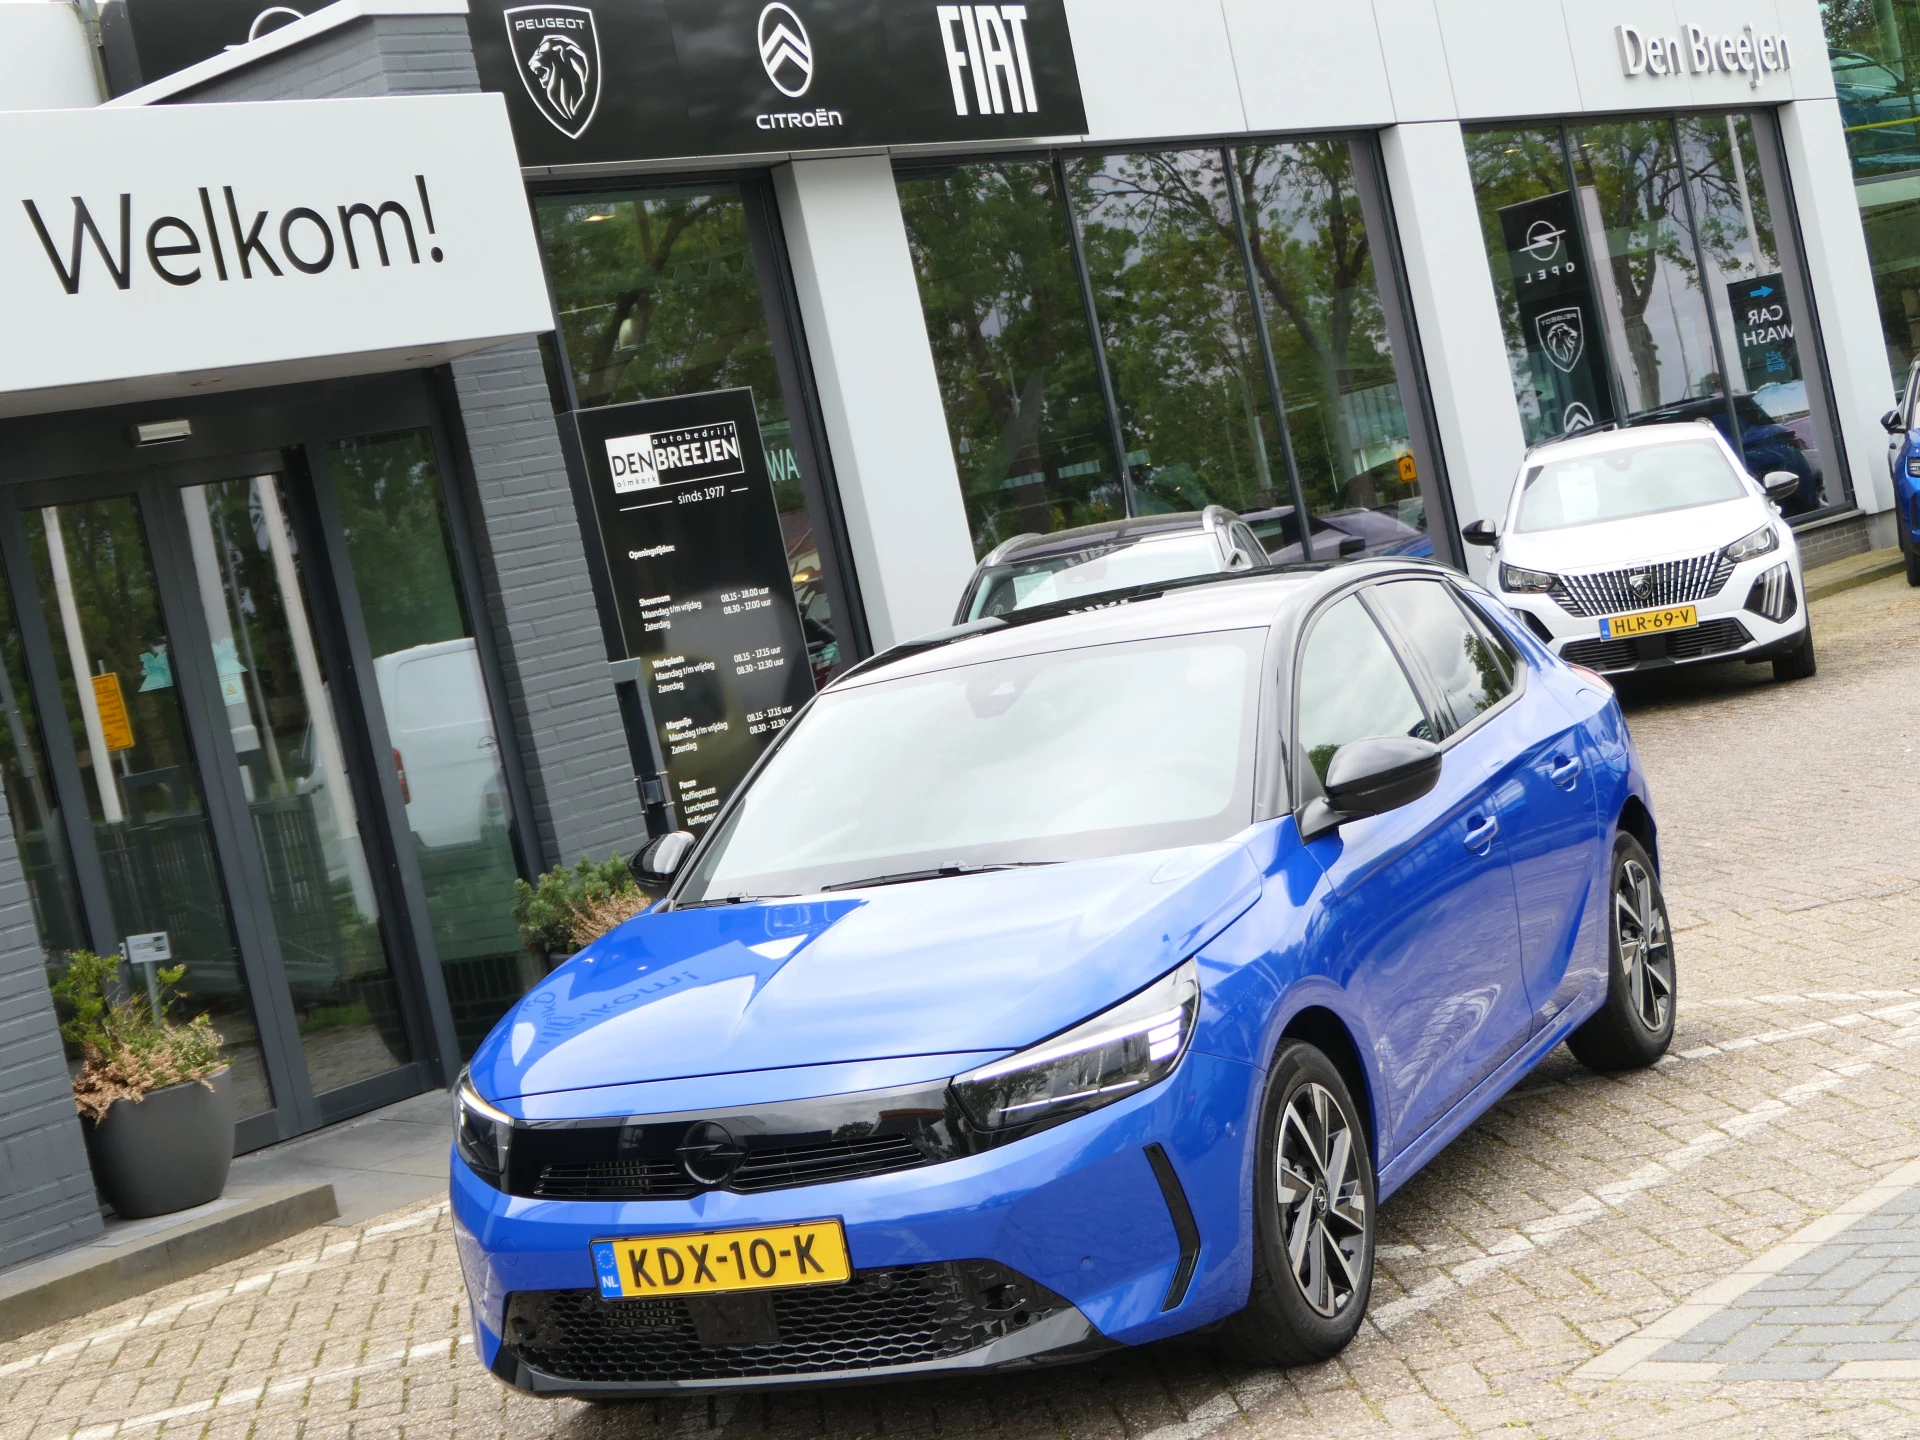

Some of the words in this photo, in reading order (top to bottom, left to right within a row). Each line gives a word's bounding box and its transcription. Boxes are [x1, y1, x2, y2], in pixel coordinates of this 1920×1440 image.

[515, 18, 586, 32] PEUGEOT
[936, 5, 1039, 117] FIAT
[1614, 24, 1684, 77] Den
[1681, 20, 1793, 89] Breejen
[21, 174, 445, 295] Welkom!
[652, 425, 734, 445] autobedrijf
[764, 448, 802, 482] WA
[616, 475, 658, 488] almkerk
[677, 490, 703, 505] sinds
[704, 485, 726, 500] 1977
[758, 586, 770, 595] uur
[641, 608, 670, 620] Maandag
[681, 600, 702, 612] vrijdag
[760, 598, 772, 607] uur
[644, 620, 671, 632] Zaterdag
[1614, 609, 1690, 634] HLR-69-V
[770, 646, 781, 655] uur
[773, 658, 784, 667] uur
[654, 669, 683, 682] Maandag
[694, 661, 716, 673] vrijdag
[657, 681, 684, 694] Zaterdag
[781, 705, 793, 714] uur
[668, 729, 696, 742] Maandag
[707, 721, 728, 733] vrijdag
[671, 742, 698, 755] Zaterdag
[681, 787, 717, 802] Koffiepauze
[684, 799, 719, 814] Lunchpauze
[627, 1232, 825, 1289] KDX-10-K
[602, 1274, 619, 1289] NL
